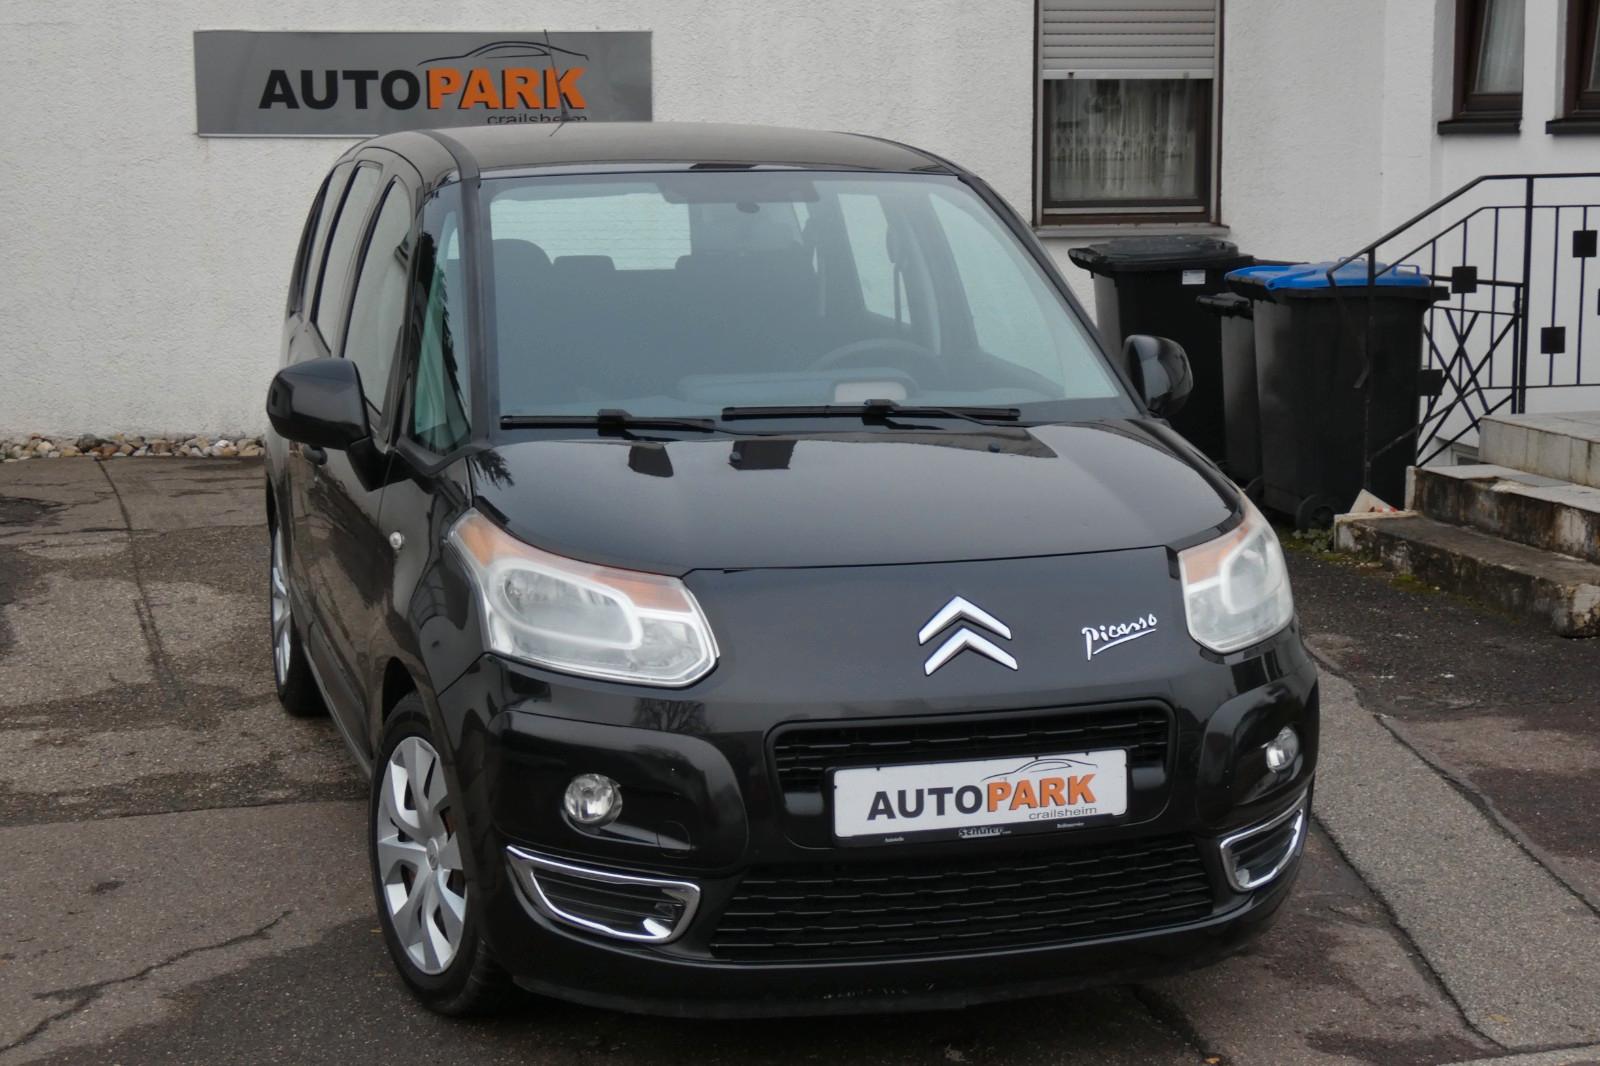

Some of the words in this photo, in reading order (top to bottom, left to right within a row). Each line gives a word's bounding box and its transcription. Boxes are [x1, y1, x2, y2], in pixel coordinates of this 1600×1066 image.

[258, 67, 587, 110] AUTOPARK
[867, 773, 1096, 821] AUTOPARK
[1028, 806, 1097, 820] crailsheim
